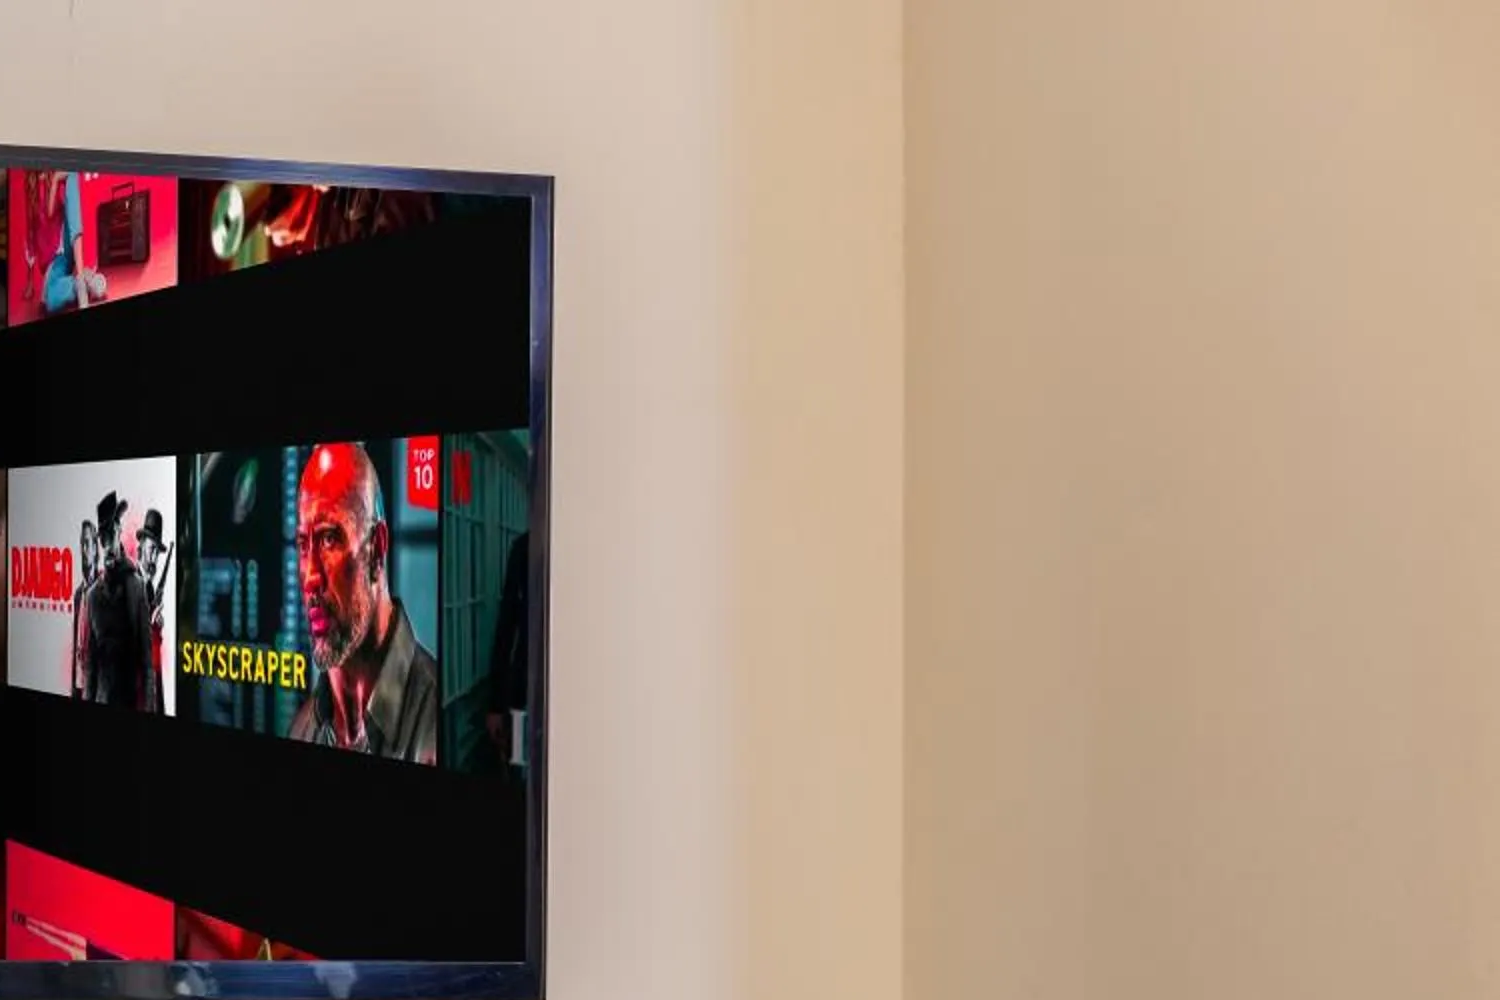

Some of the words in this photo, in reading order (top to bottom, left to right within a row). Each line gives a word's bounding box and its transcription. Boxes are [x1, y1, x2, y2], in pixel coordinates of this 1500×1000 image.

[413, 448, 436, 462] TOP
[414, 464, 434, 490] 10
[11, 545, 74, 601] DJANGO
[182, 640, 308, 690] SKYSCRAPER
